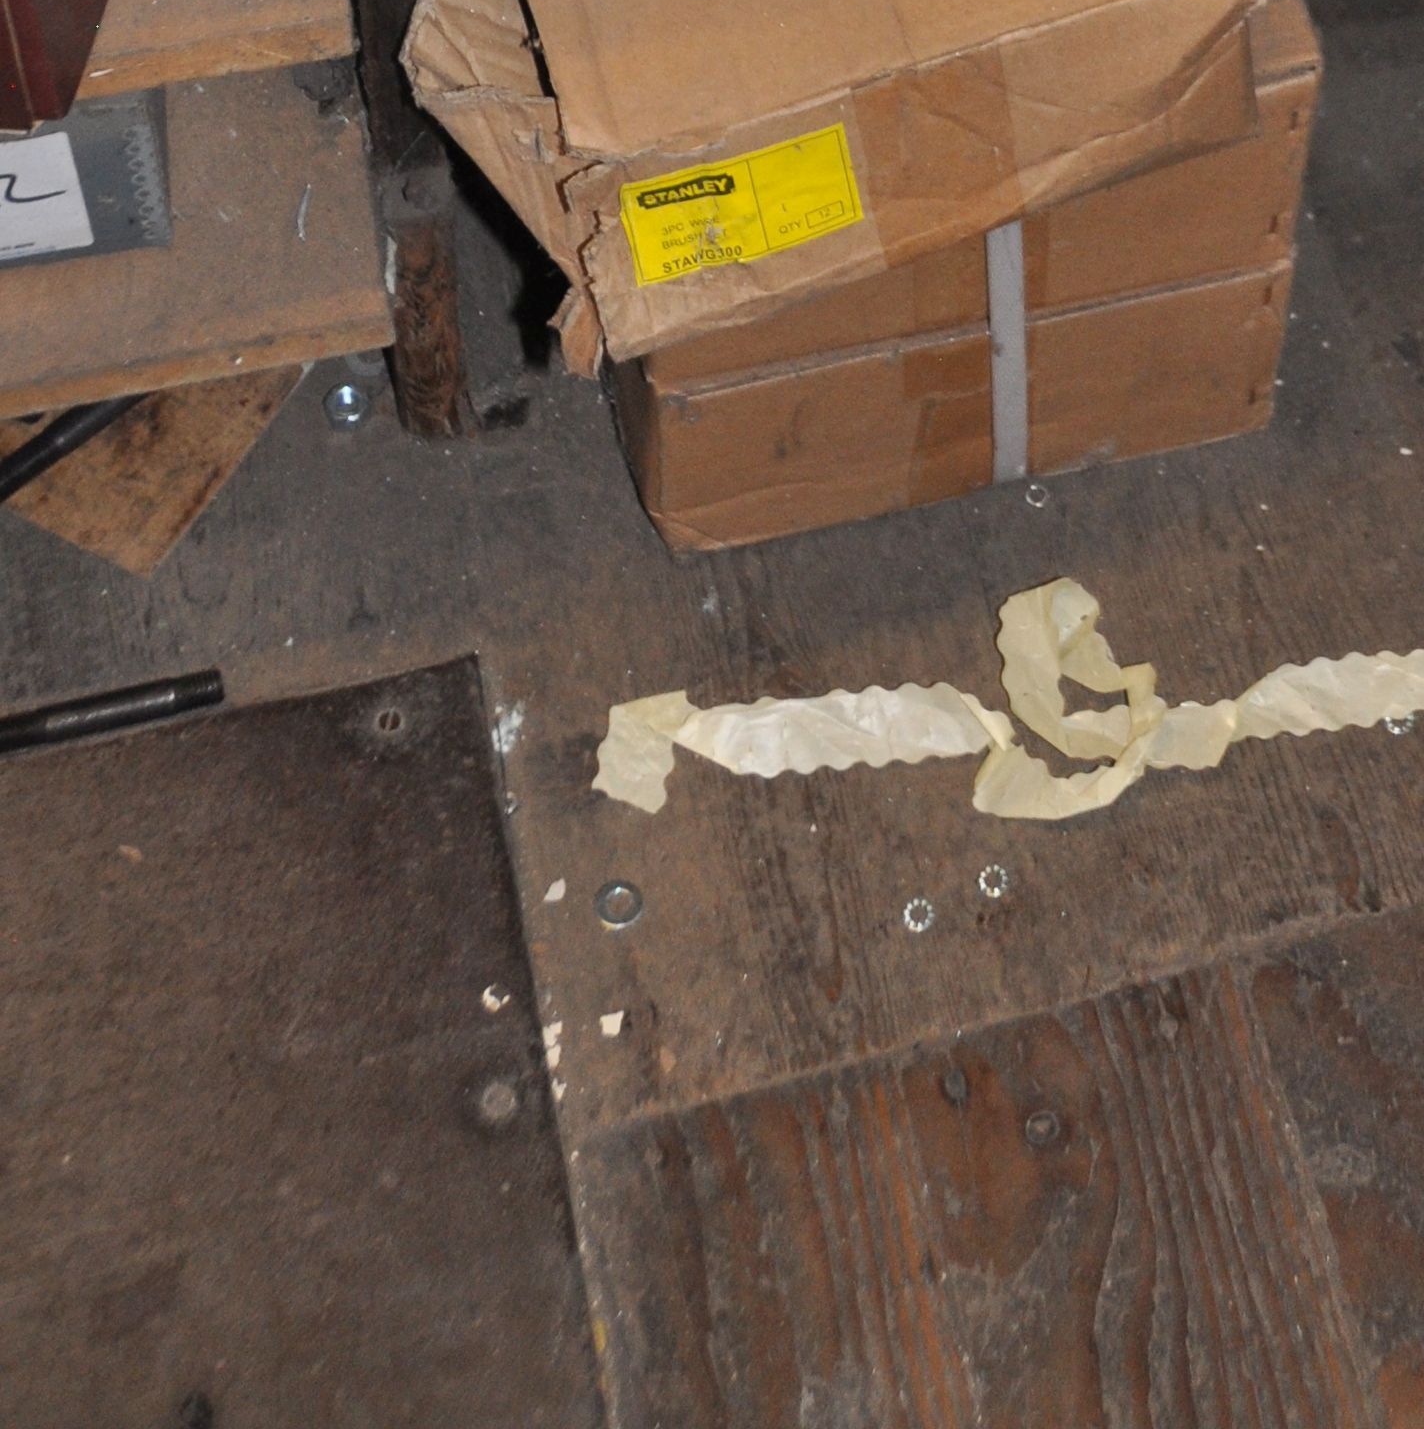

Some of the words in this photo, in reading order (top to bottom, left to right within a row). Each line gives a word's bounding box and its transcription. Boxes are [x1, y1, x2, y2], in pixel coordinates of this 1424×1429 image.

[643, 178, 728, 205] STANLEY
[779, 219, 802, 234] QTY
[818, 207, 831, 220] 12
